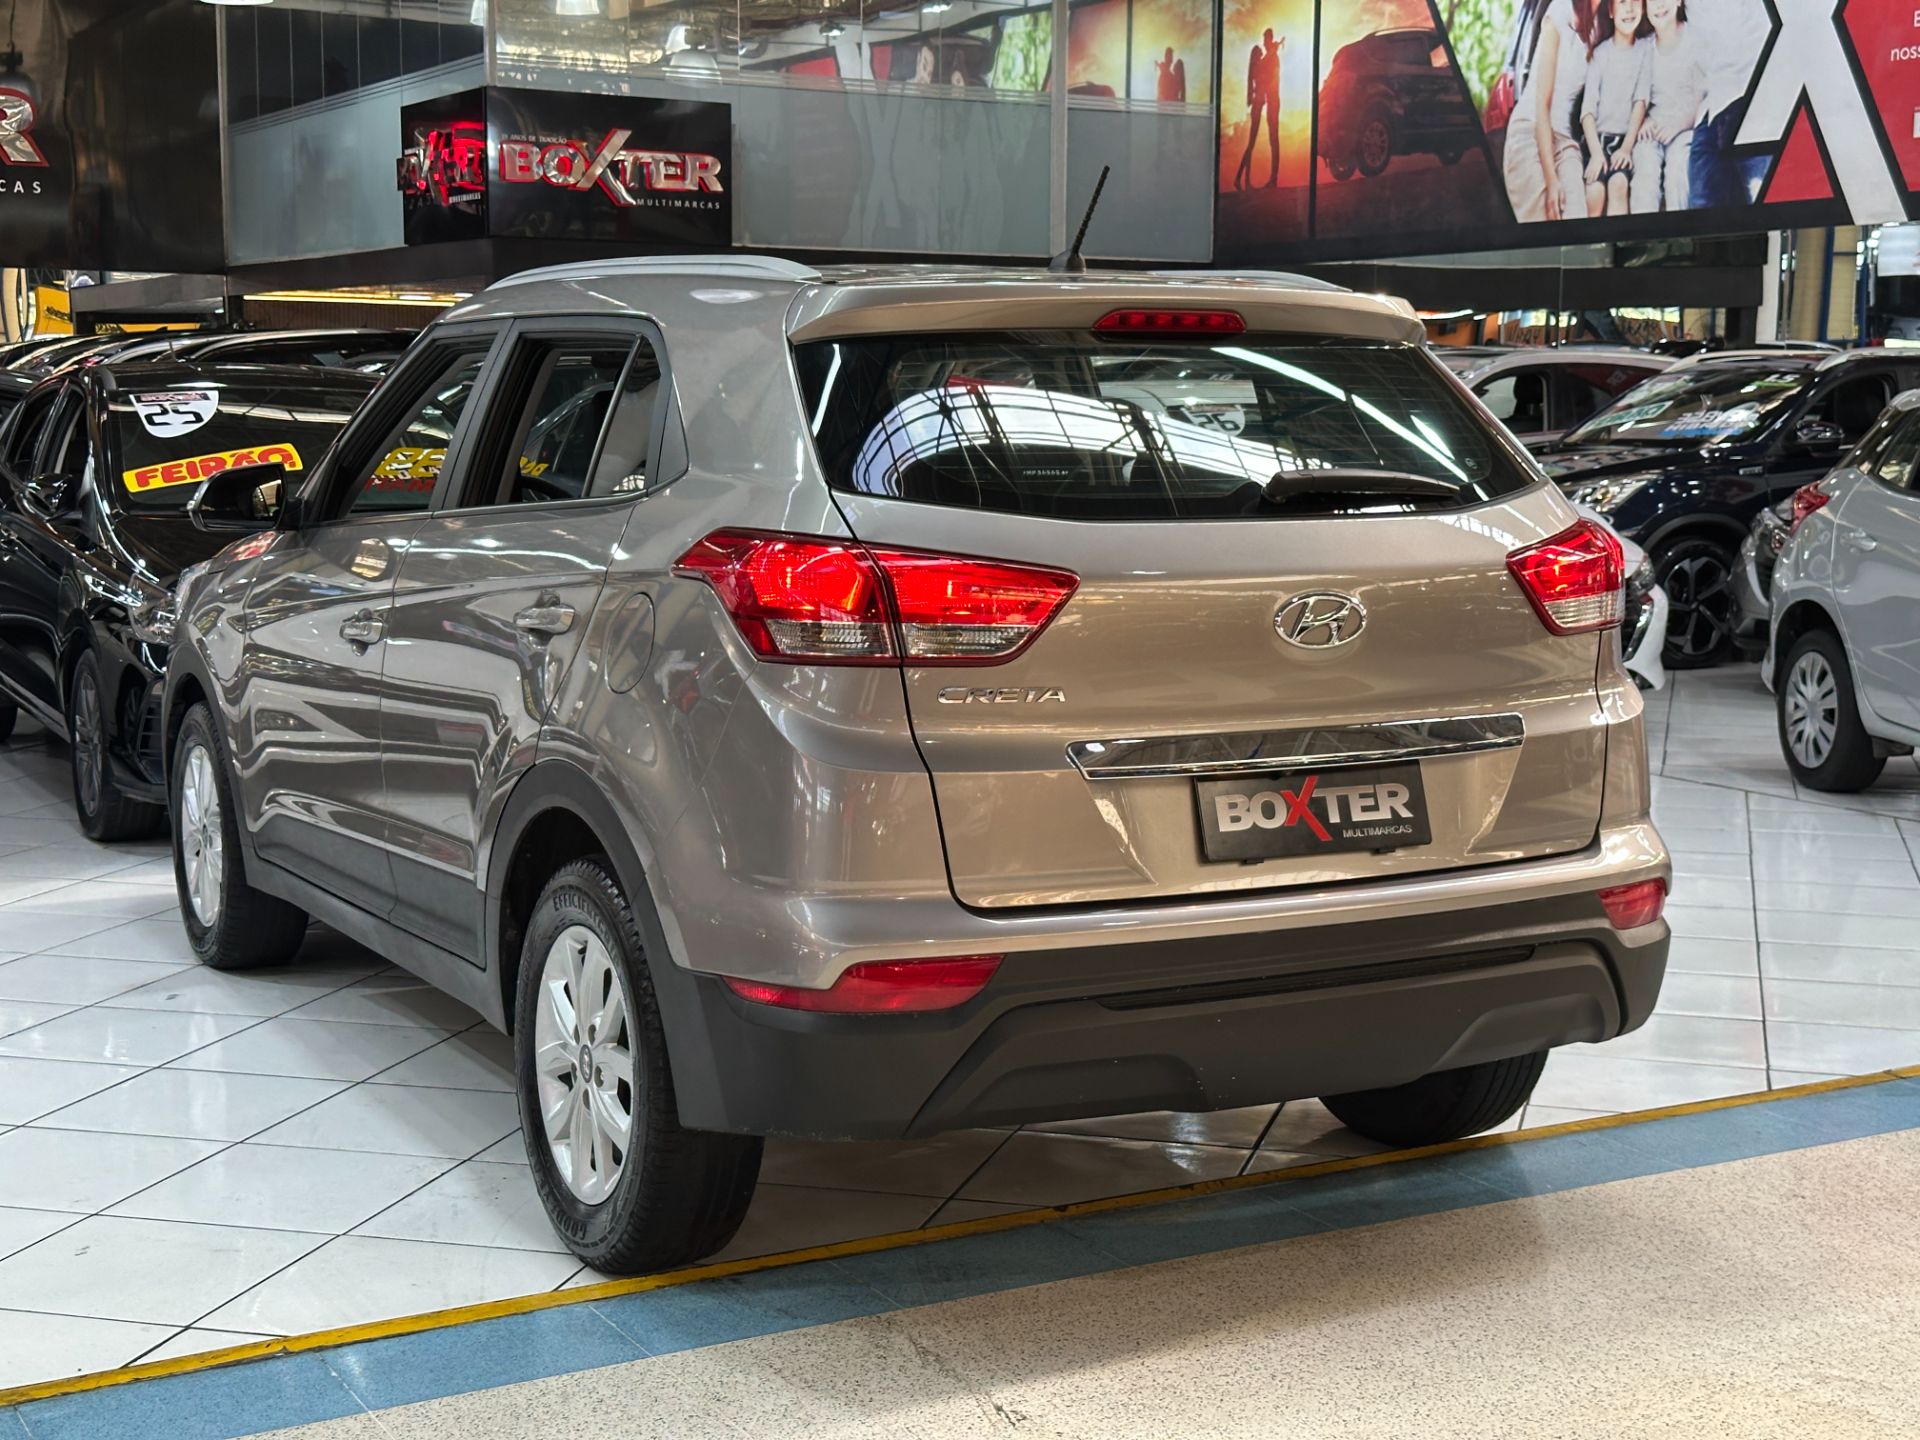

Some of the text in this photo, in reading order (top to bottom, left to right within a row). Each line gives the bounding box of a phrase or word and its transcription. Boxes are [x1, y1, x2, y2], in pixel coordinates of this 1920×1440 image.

[499, 128, 724, 207] BOXTER
[636, 198, 721, 210] MULTIMARCAS
[937, 686, 1066, 704] CRETA
[1214, 775, 1415, 842] BOXTER
[1343, 824, 1413, 839] MULTIMARCAS
